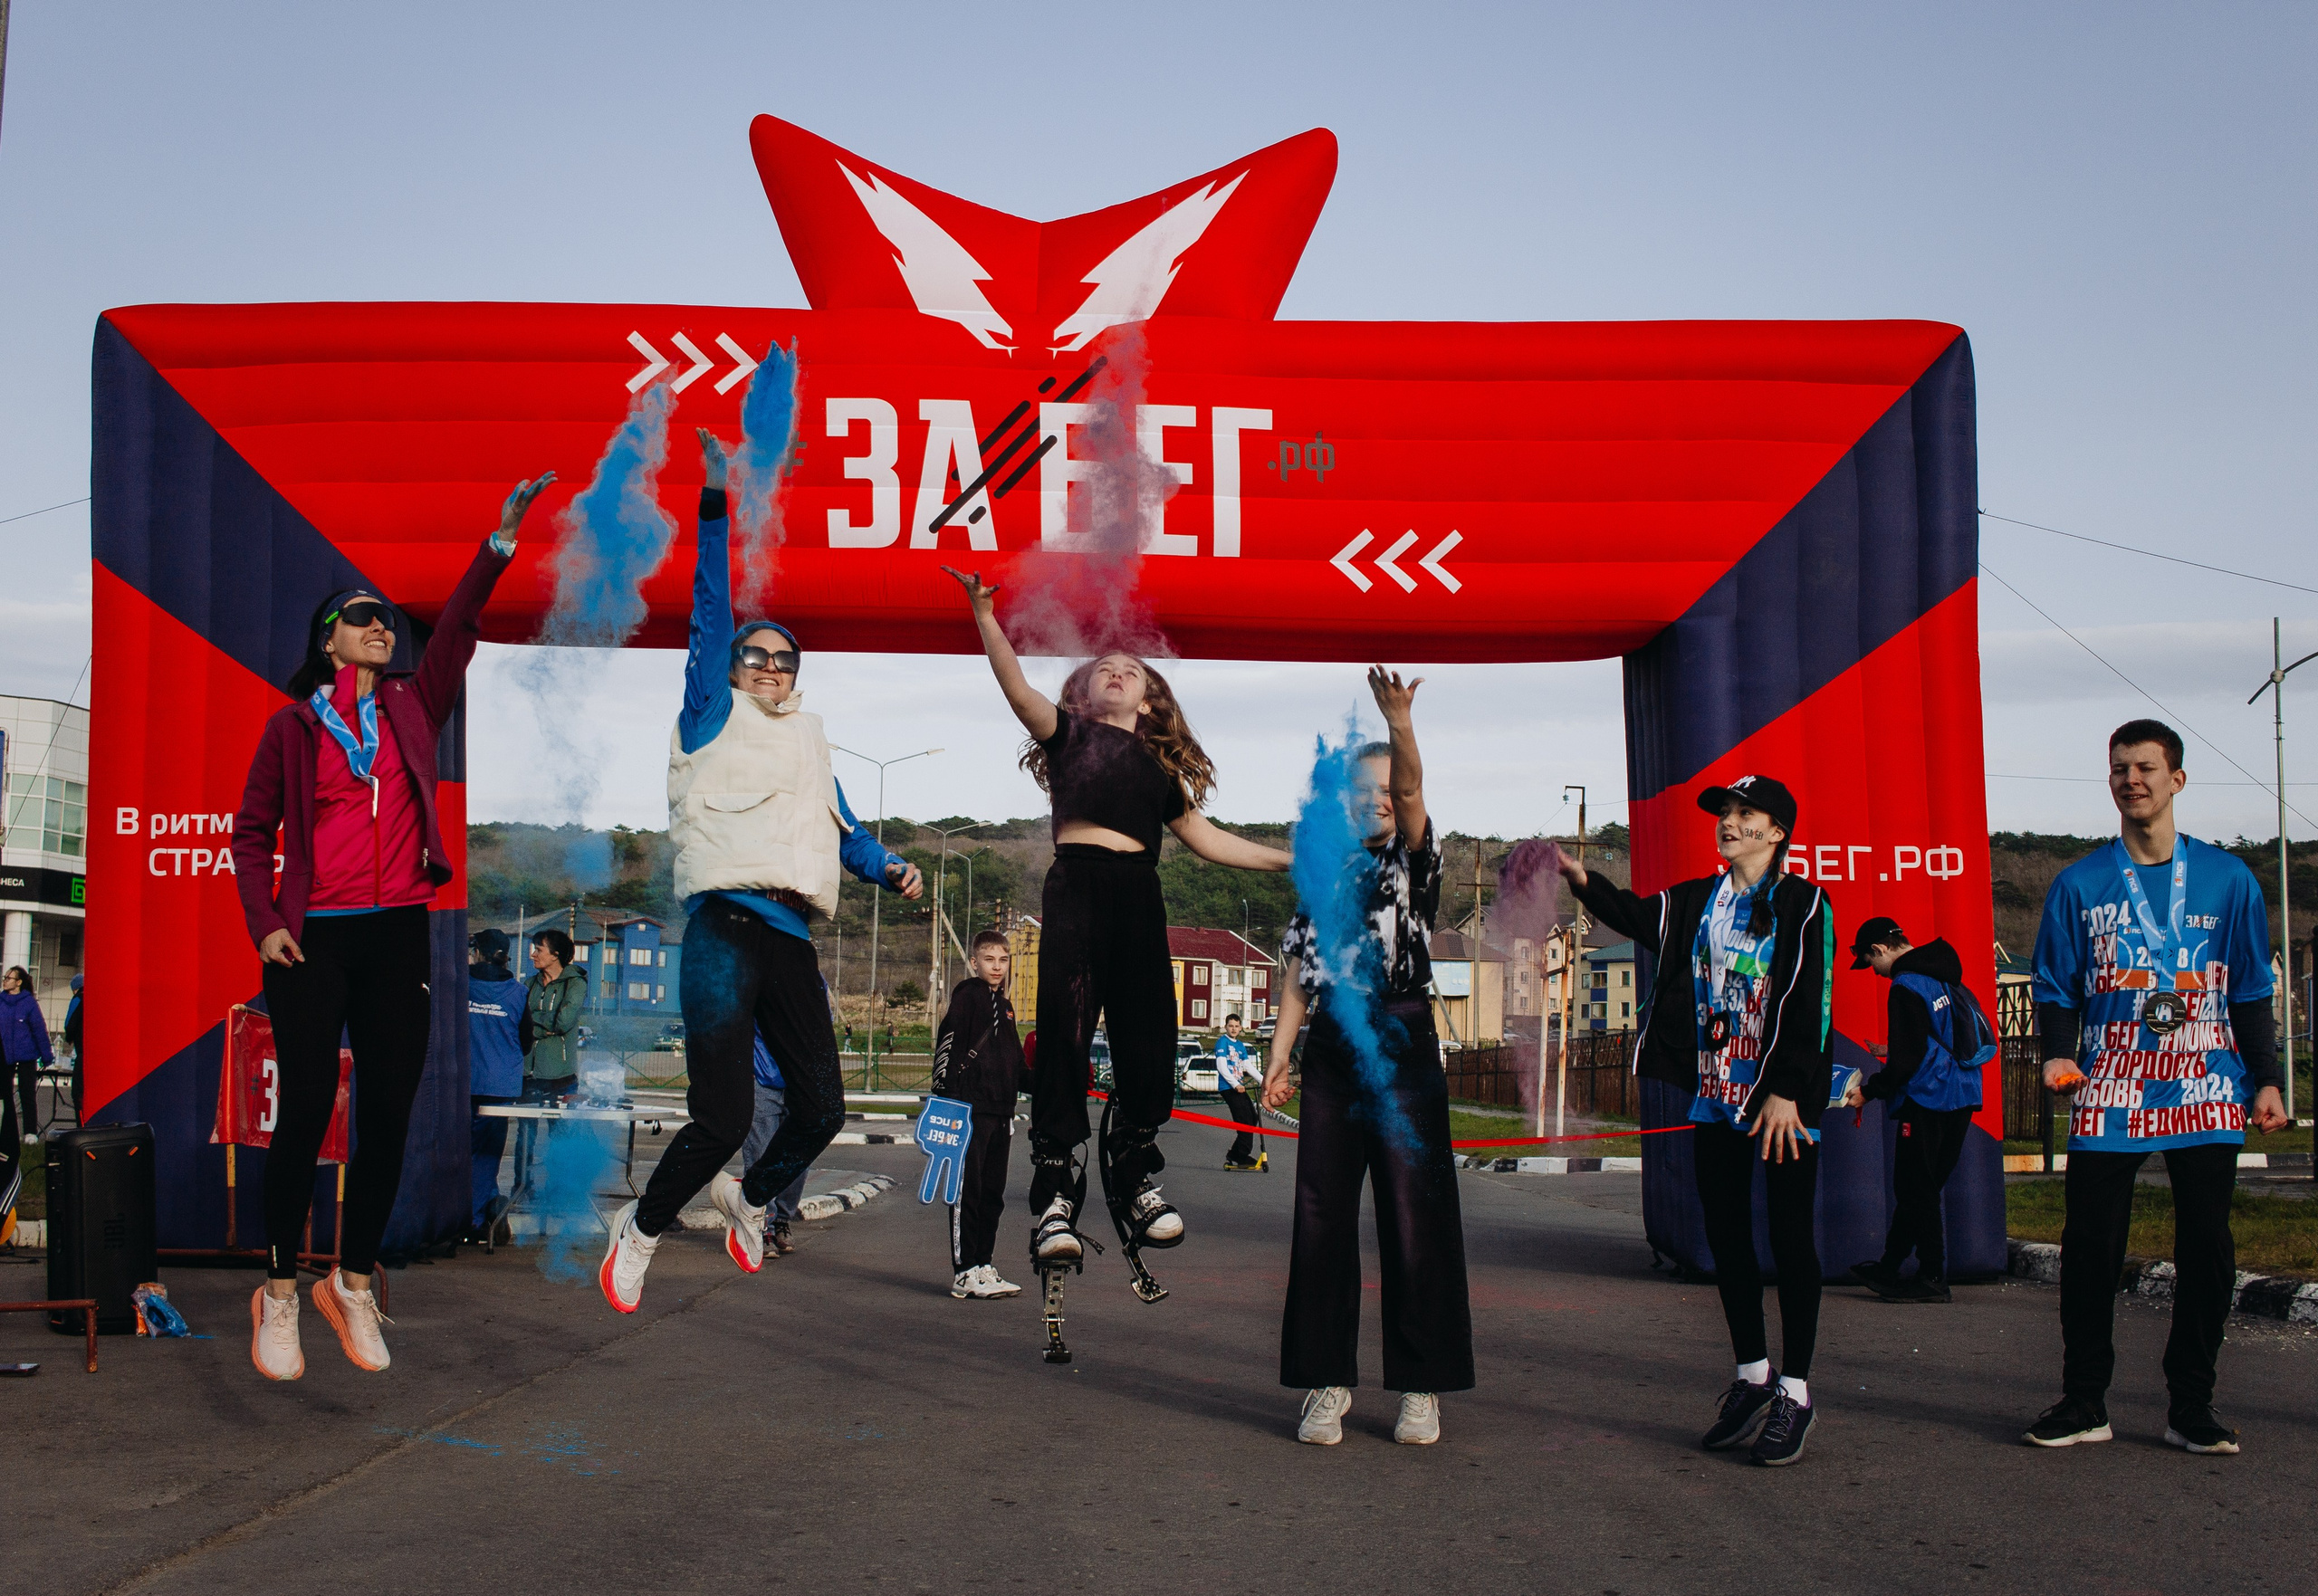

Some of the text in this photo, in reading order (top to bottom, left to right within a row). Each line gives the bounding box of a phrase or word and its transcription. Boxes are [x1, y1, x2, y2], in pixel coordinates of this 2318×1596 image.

[116, 807, 234, 840] В ритм
[1717, 844, 1965, 882] БЕГ.РФ
[0, 877, 25, 887] НЕСА
[2082, 900, 2131, 937] 2024
[1725, 929, 1757, 953] 005
[2091, 1050, 2208, 1082] #ГОРДОСТЬ
[2180, 1073, 2234, 1104] 2024
